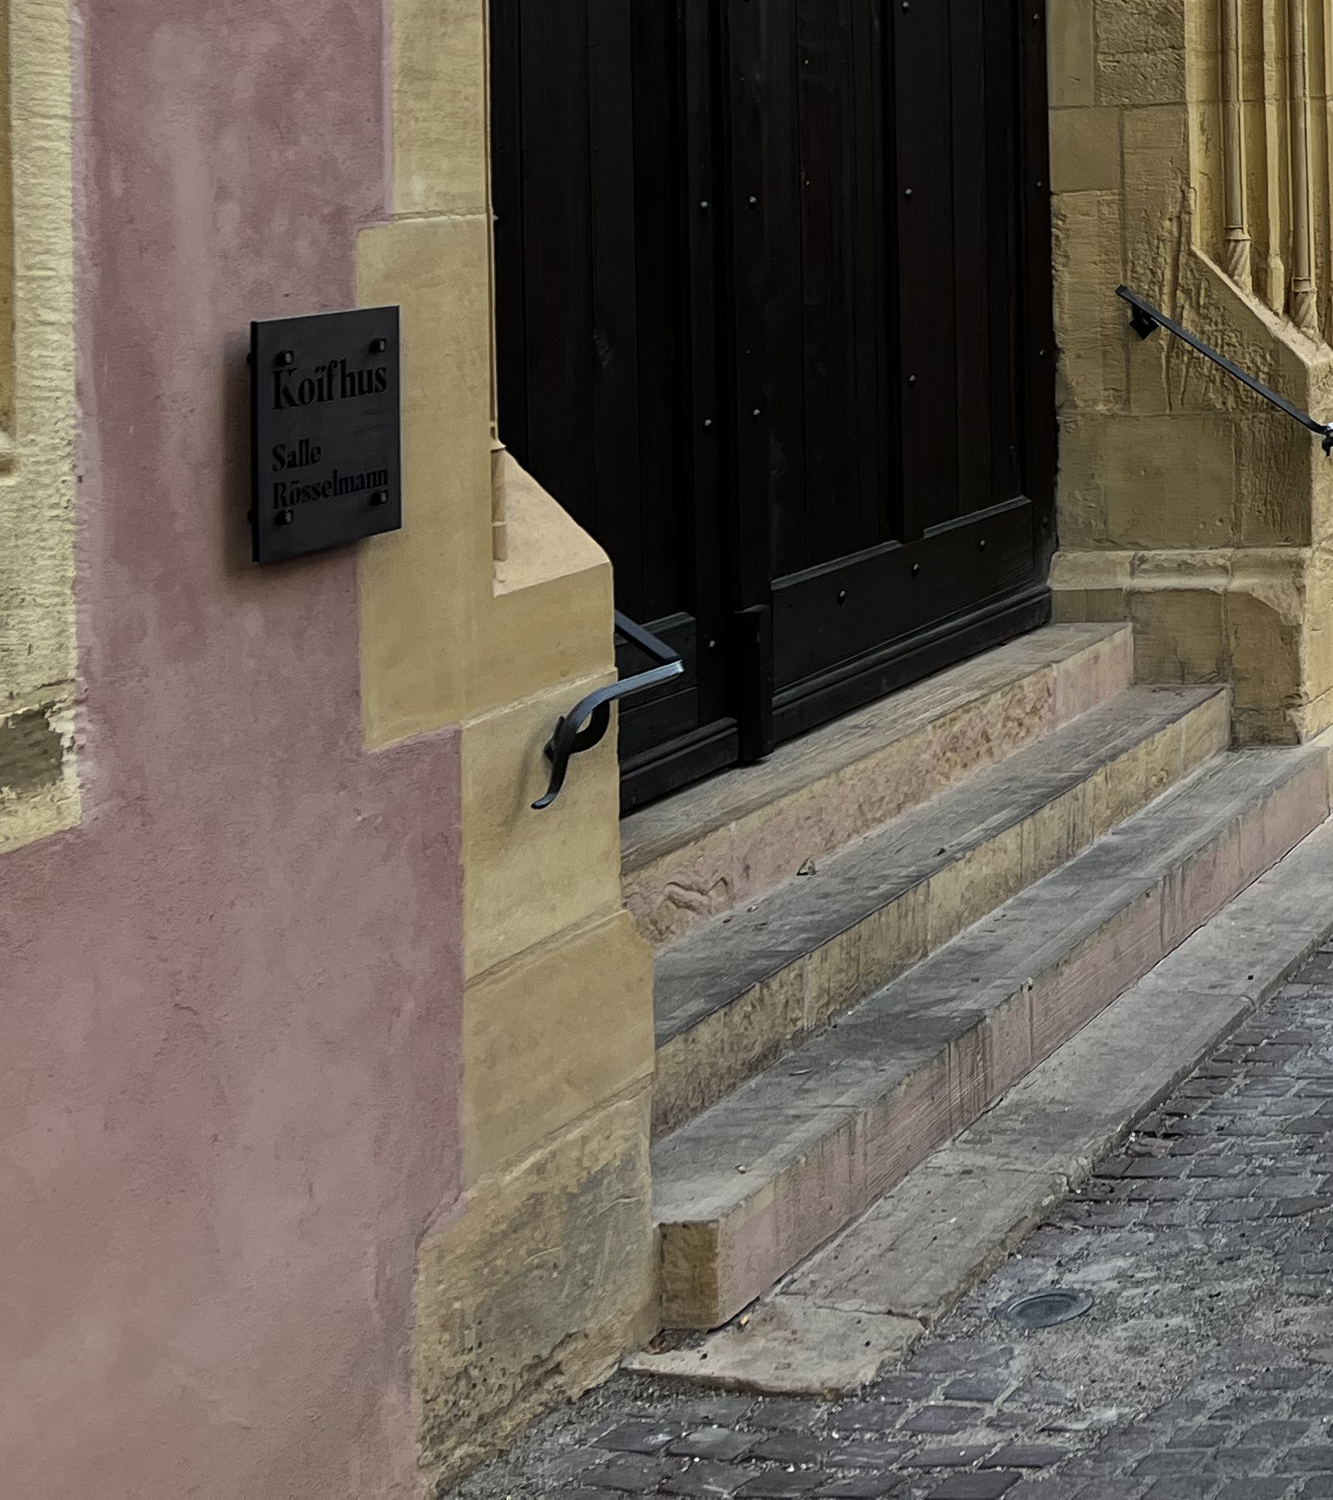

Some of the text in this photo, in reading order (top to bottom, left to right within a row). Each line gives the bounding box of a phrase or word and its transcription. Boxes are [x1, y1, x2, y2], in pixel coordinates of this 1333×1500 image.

[271, 358, 388, 411] Koïfhus
[271, 438, 322, 472] Salle
[272, 467, 389, 510] Rösselmann
